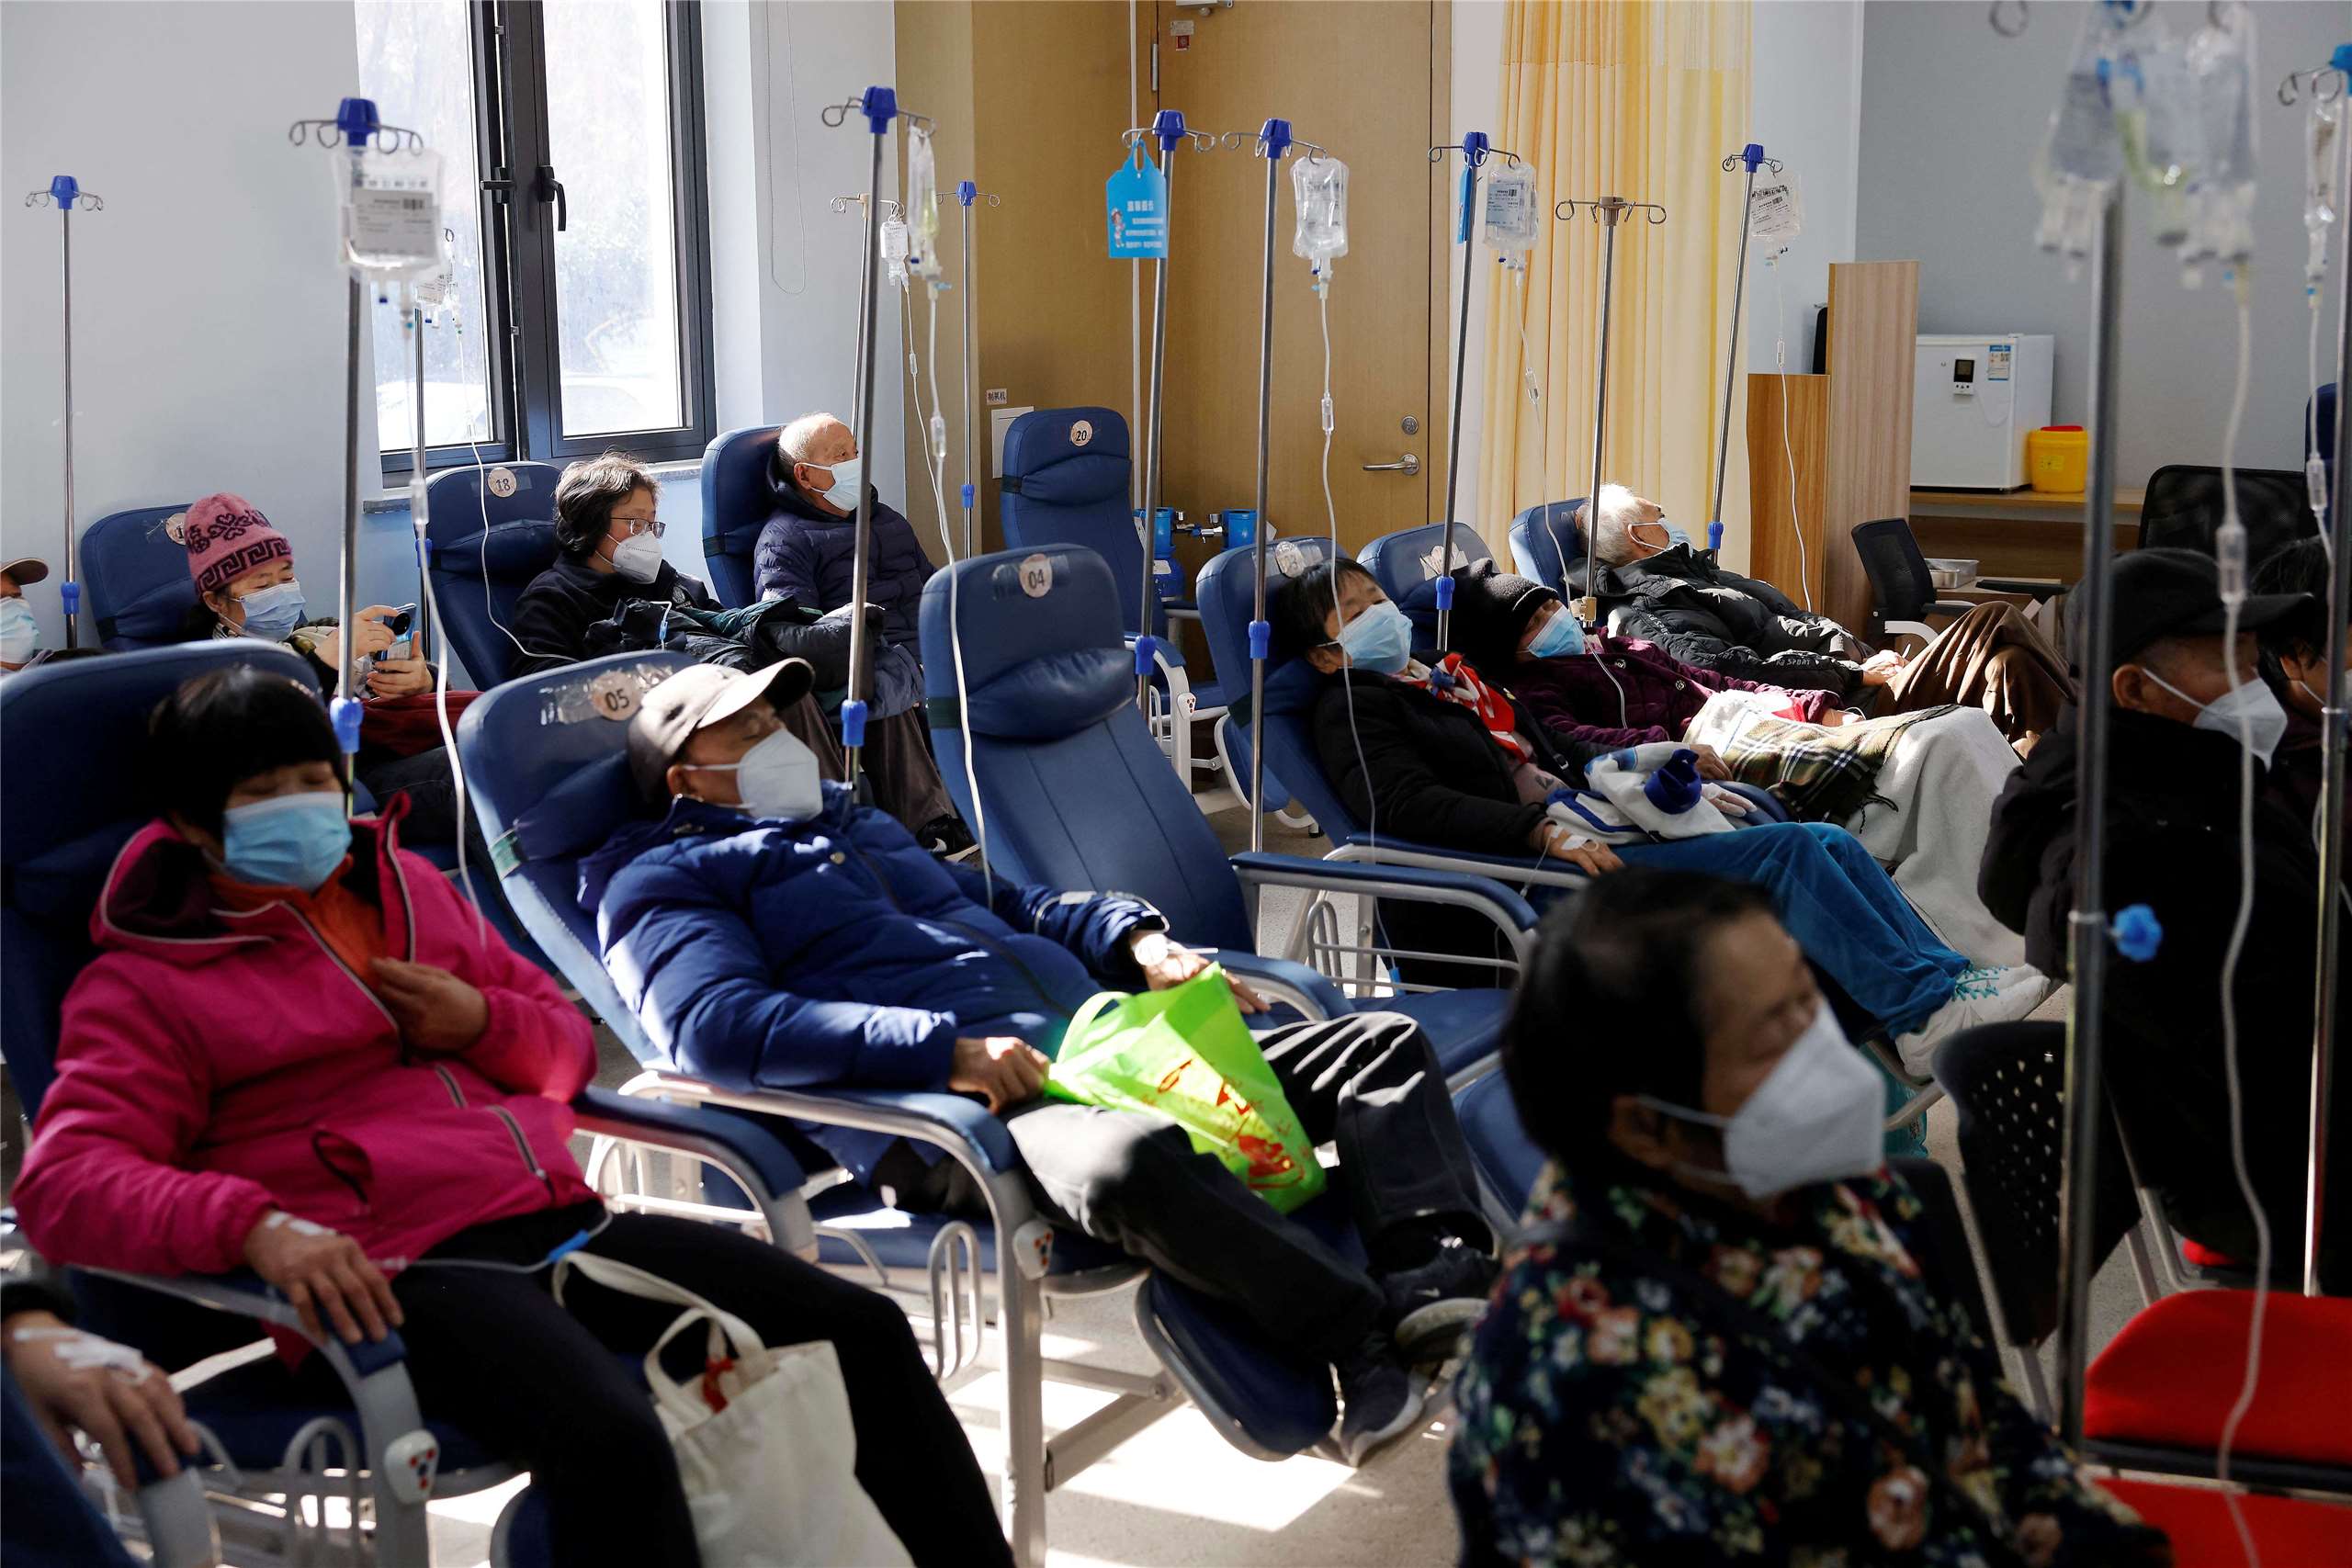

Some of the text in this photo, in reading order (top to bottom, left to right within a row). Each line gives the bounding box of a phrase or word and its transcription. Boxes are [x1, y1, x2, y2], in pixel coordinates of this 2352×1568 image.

[1076, 430, 1088, 441] 20
[495, 478, 511, 492] 18
[1028, 569, 1045, 590] 04
[605, 688, 630, 712] 05
